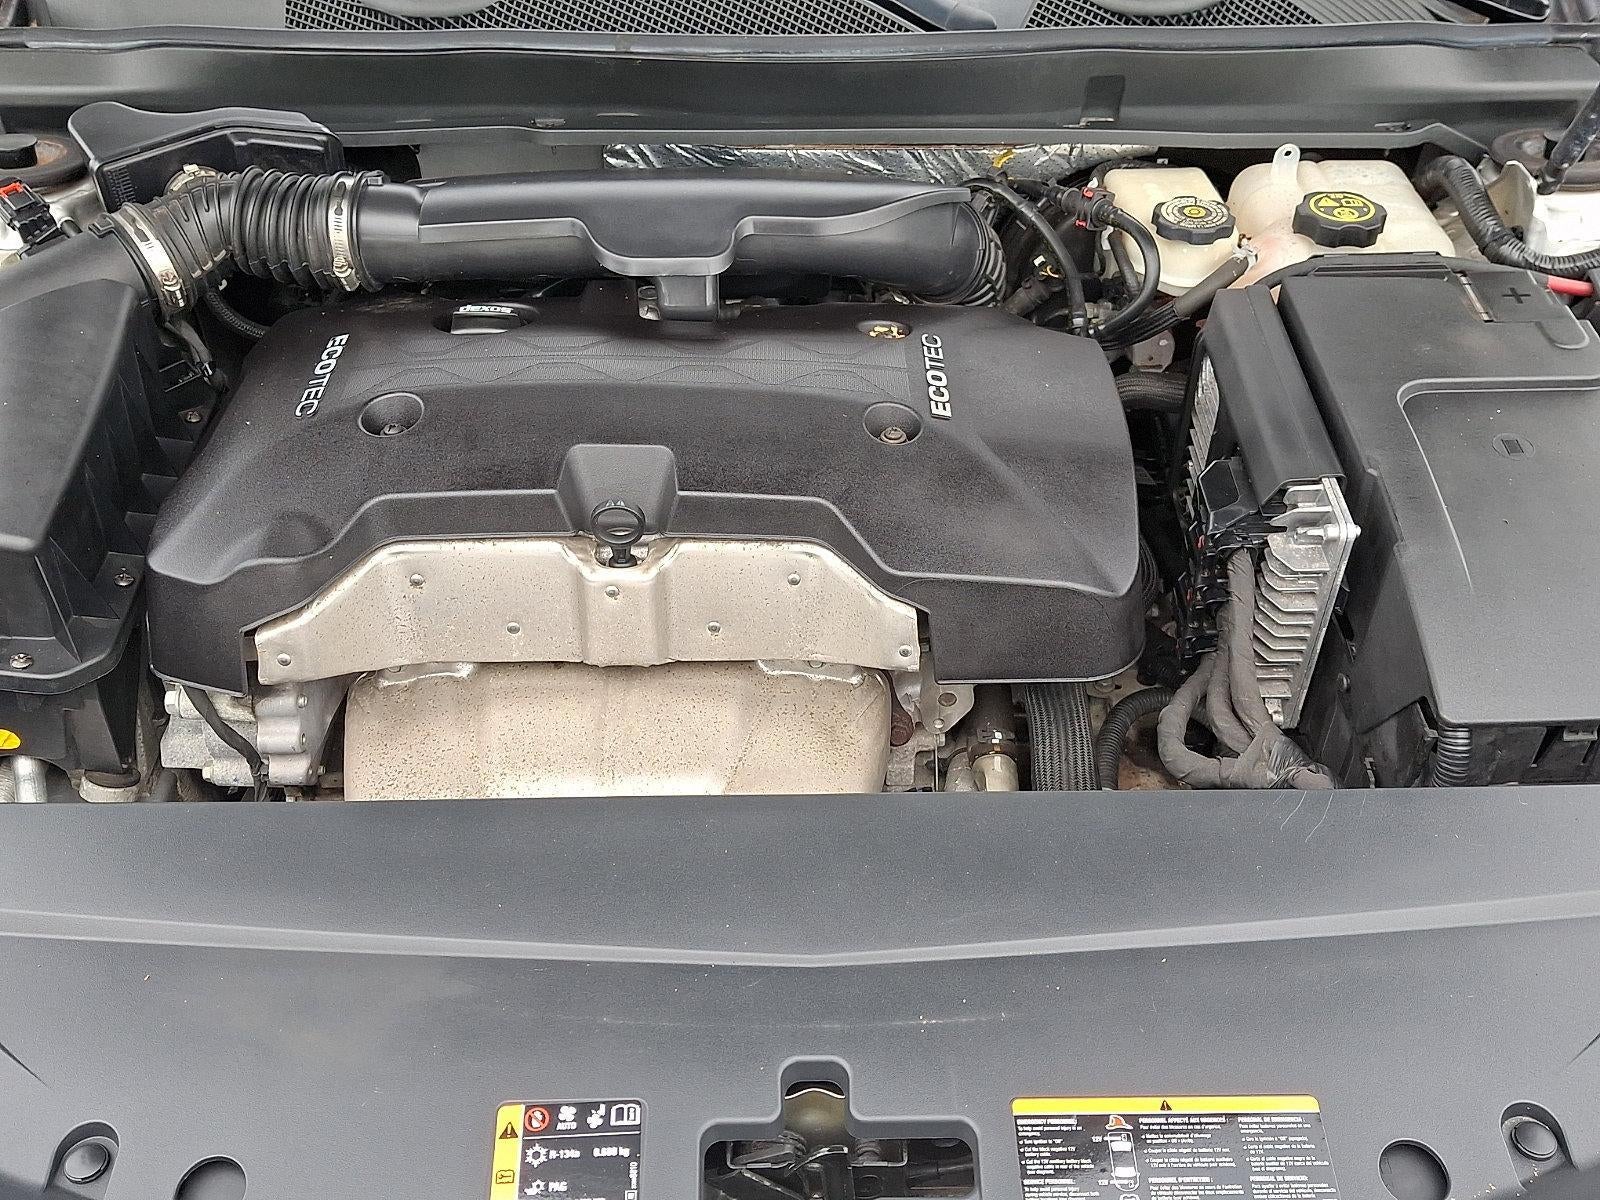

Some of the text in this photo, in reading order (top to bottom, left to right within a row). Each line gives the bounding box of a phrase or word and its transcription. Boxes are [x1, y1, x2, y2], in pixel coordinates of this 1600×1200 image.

[459, 304, 514, 314] dexos
[294, 333, 350, 418] ECOTEC
[921, 333, 952, 419] ECOTEC
